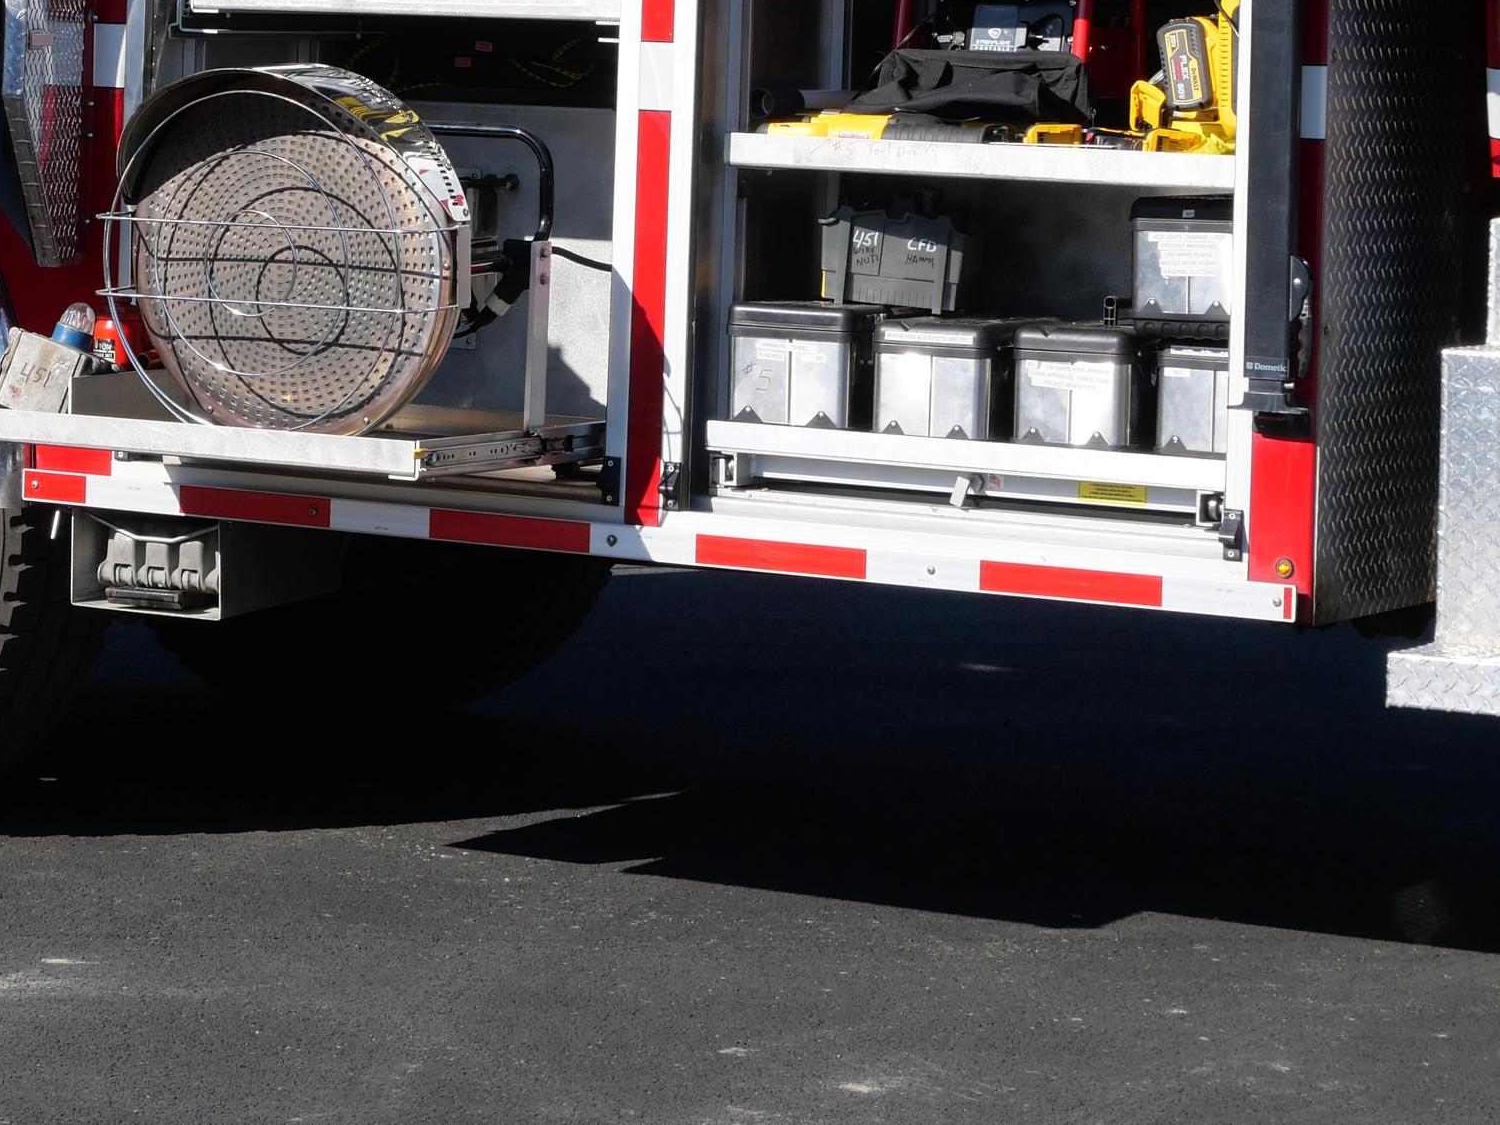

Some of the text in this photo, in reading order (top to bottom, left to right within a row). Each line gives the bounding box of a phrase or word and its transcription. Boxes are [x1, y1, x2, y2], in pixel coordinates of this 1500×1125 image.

[852, 229, 879, 248] 451
[907, 237, 937, 252] CFD
[20, 362, 52, 387] 451
[1254, 362, 1288, 372] Dometic
